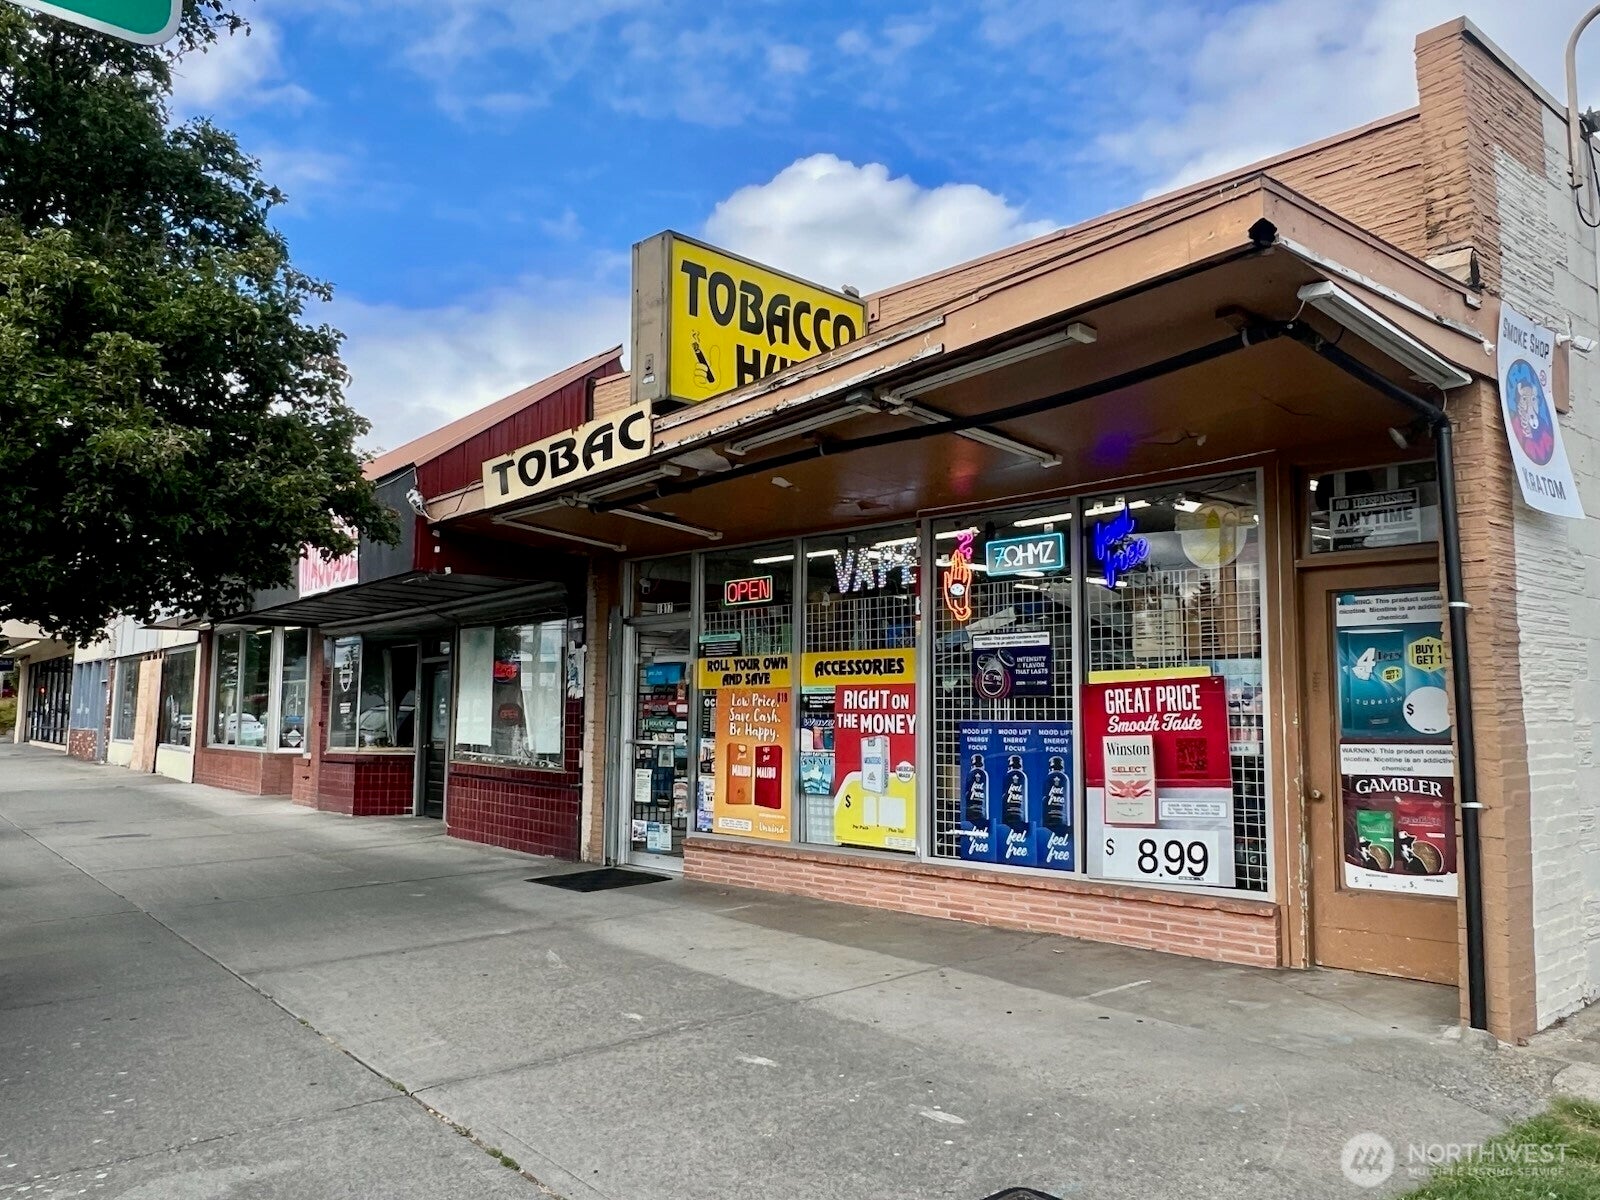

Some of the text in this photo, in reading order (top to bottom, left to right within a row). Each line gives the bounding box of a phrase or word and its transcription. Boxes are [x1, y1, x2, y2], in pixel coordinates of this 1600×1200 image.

[680, 259, 856, 354] TOBACCO
[1503, 317, 1550, 360] SMOKE SHOP
[491, 410, 646, 496] TOBAC
[1521, 467, 1567, 501] KRATOM
[1337, 506, 1414, 528] ANYTIME
[833, 542, 918, 594] VAPE
[727, 578, 770, 603] OPEN
[1415, 644, 1442, 655] BUY 1
[707, 656, 788, 672] ROLL YOUR OWN
[814, 657, 905, 678] ACCESSORIES
[1416, 654, 1442, 665] GET 1
[722, 672, 771, 686] AND SAVE
[731, 693, 780, 708] Low Price.
[843, 689, 891, 710] RIGHT
[891, 694, 909, 710] ON
[1104, 684, 1202, 715] GREAT PRICE
[729, 707, 750, 722] Save
[753, 707, 781, 724] Cash.
[1406, 703, 1415, 716] $
[837, 713, 859, 729] THE
[860, 713, 917, 735] MONEY
[1107, 712, 1203, 734] Smooth Taste
[729, 722, 780, 743] Be Happy.
[1043, 737, 1069, 745] ENERGY
[1106, 741, 1150, 757] Winston
[1111, 766, 1147, 774] SELECT
[970, 790, 985, 801] free
[971, 782, 984, 792] feel
[1007, 783, 1022, 794] feel
[1049, 785, 1063, 795] feel
[1355, 777, 1443, 798] GAMBLER
[845, 794, 851, 809] $
[1007, 792, 1023, 803] free
[1048, 793, 1065, 806] free
[1006, 828, 1027, 845] feel
[1047, 832, 1069, 848] feel
[968, 839, 989, 855] free
[1005, 842, 1028, 859] free
[1046, 846, 1070, 863] free
[1105, 837, 1209, 877] $ 8.99
